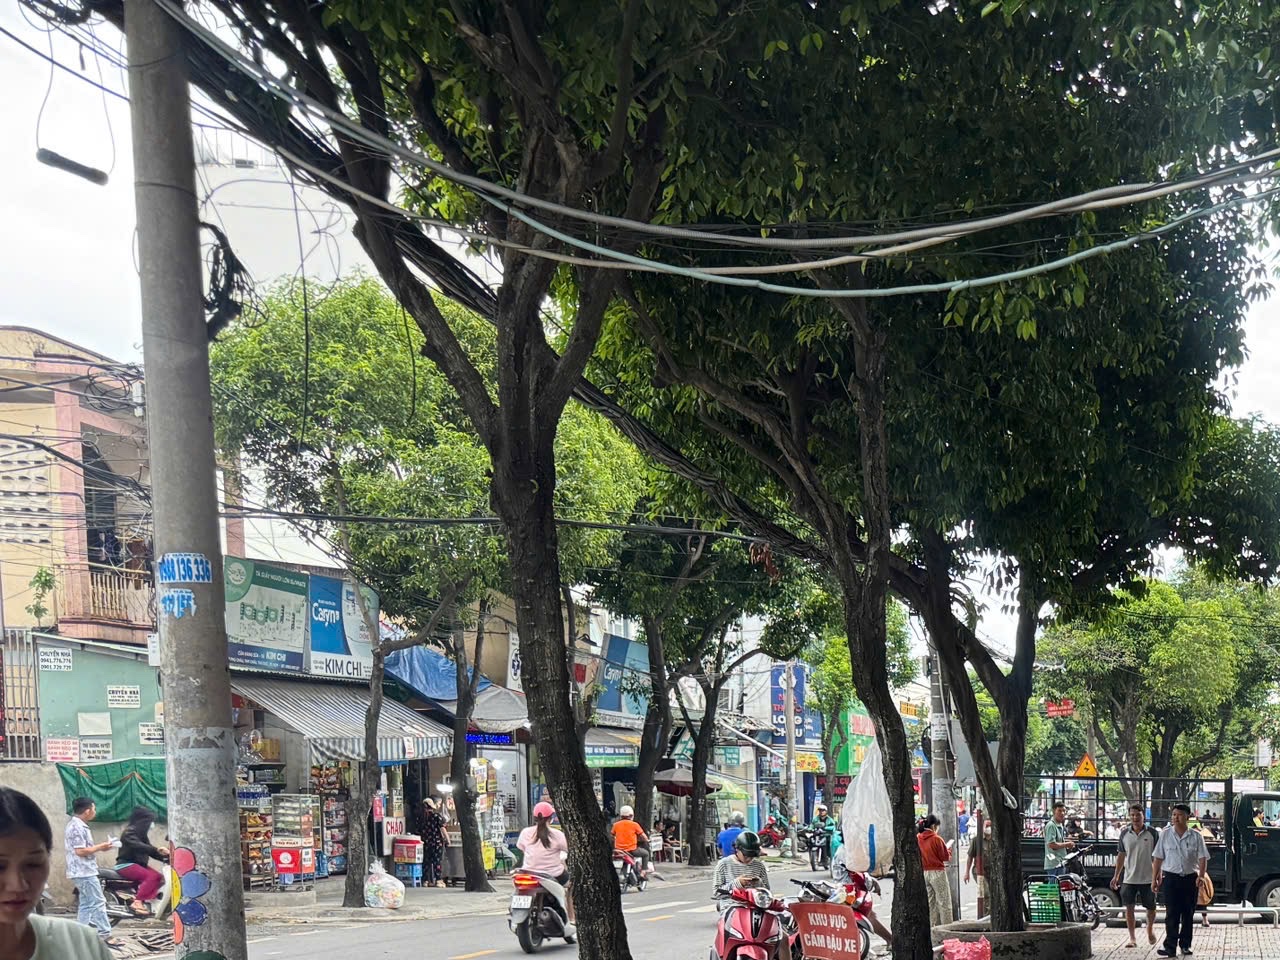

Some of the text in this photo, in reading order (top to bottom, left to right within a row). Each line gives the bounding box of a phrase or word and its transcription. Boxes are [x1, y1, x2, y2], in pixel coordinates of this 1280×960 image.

[325, 657, 344, 675] KIM
[346, 661, 362, 677] CHI
[772, 715, 803, 725] LOG
[773, 727, 803, 737] CHU
[1084, 853, 1103, 867] NHÂN
[808, 912, 848, 932] KHU VỰC
[803, 929, 857, 953] CẤM ĐẬU XE
